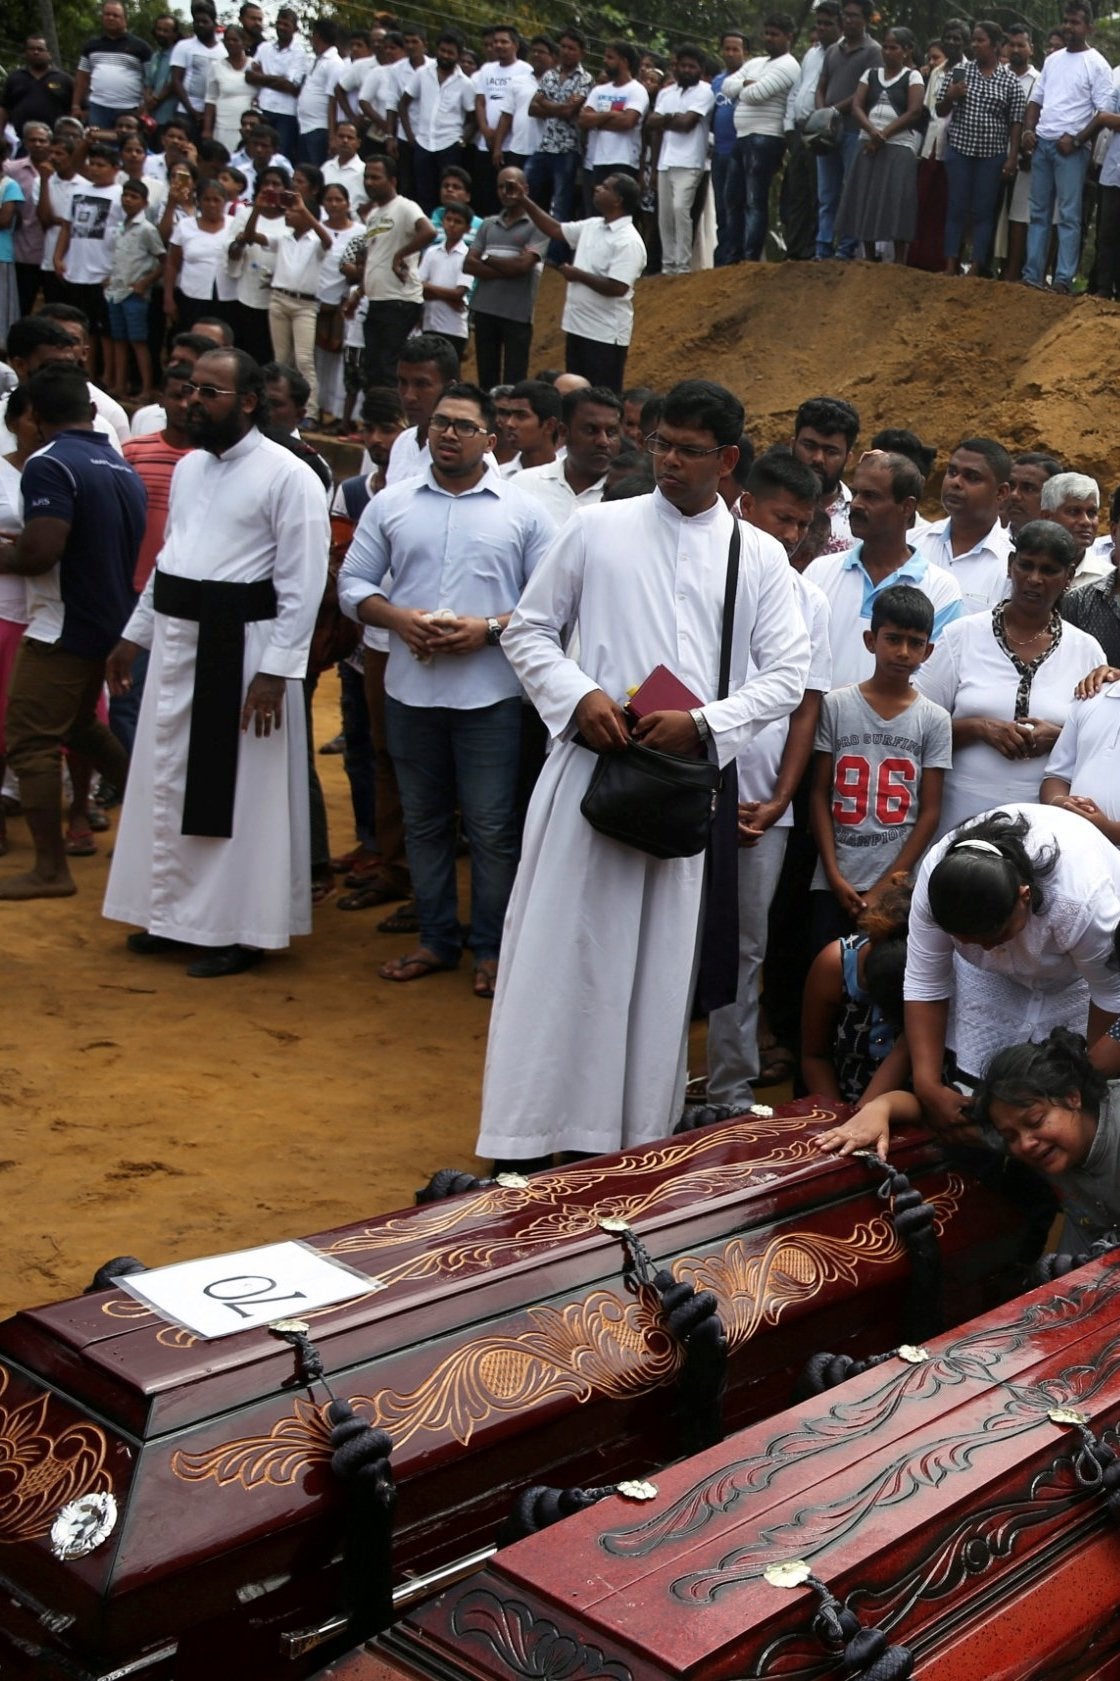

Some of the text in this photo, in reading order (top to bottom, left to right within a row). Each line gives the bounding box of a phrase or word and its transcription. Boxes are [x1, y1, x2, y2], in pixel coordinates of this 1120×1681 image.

[834, 733, 925, 756] PRO SURFING
[832, 754, 917, 826] 96
[203, 1275, 307, 1318] 70
